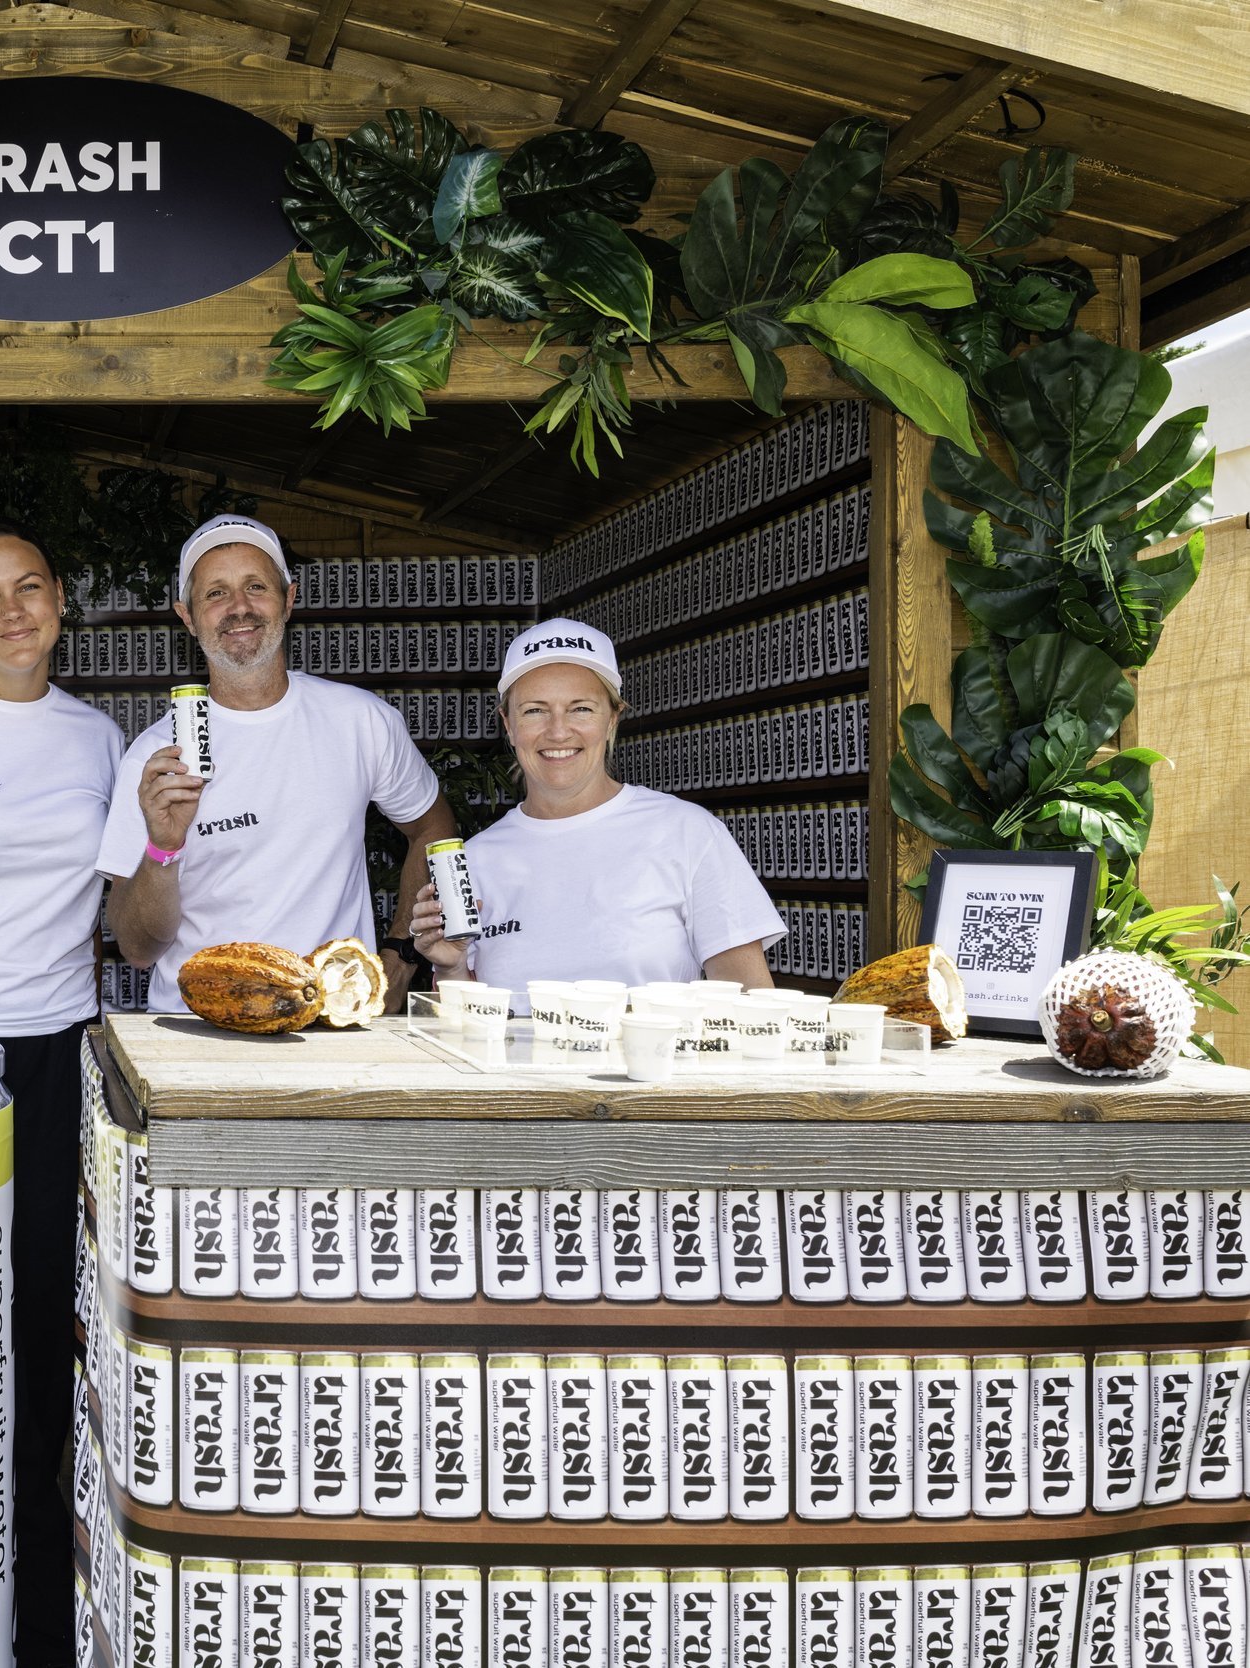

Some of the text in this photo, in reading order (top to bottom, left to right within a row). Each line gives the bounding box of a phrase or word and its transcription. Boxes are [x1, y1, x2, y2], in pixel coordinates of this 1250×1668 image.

[348, 564, 359, 604] trash
[406, 563, 419, 604] trash
[467, 562, 479, 602] trash
[523, 636, 595, 656] trash
[370, 630, 382, 670] trash
[468, 628, 479, 668] trash
[196, 700, 212, 775] trash
[197, 811, 259, 836] trash
[454, 853, 479, 928] trash
[474, 919, 522, 942] rash
[966, 891, 1045, 903] SCAN TO WIN
[964, 990, 1029, 1004] rash.drinks
[134, 1365, 161, 1488] trash
[194, 1370, 228, 1498] trash
[253, 1372, 287, 1501] trash
[314, 1374, 348, 1502] trash
[374, 1375, 409, 1504] trash
[435, 1376, 470, 1505] trash
[502, 1376, 538, 1507] trash
[561, 1377, 597, 1507] trash
[621, 1377, 658, 1508] trash
[682, 1377, 718, 1508] trash
[742, 1378, 778, 1508] trash
[810, 1378, 844, 1508] trash
[869, 1378, 903, 1507] trash
[927, 1377, 961, 1506] trash
[985, 1376, 1019, 1504] trash
[1042, 1374, 1076, 1503] trash
[1106, 1372, 1140, 1501] trash
[1154, 1371, 1193, 1494] trash
[1200, 1368, 1241, 1488] trash
